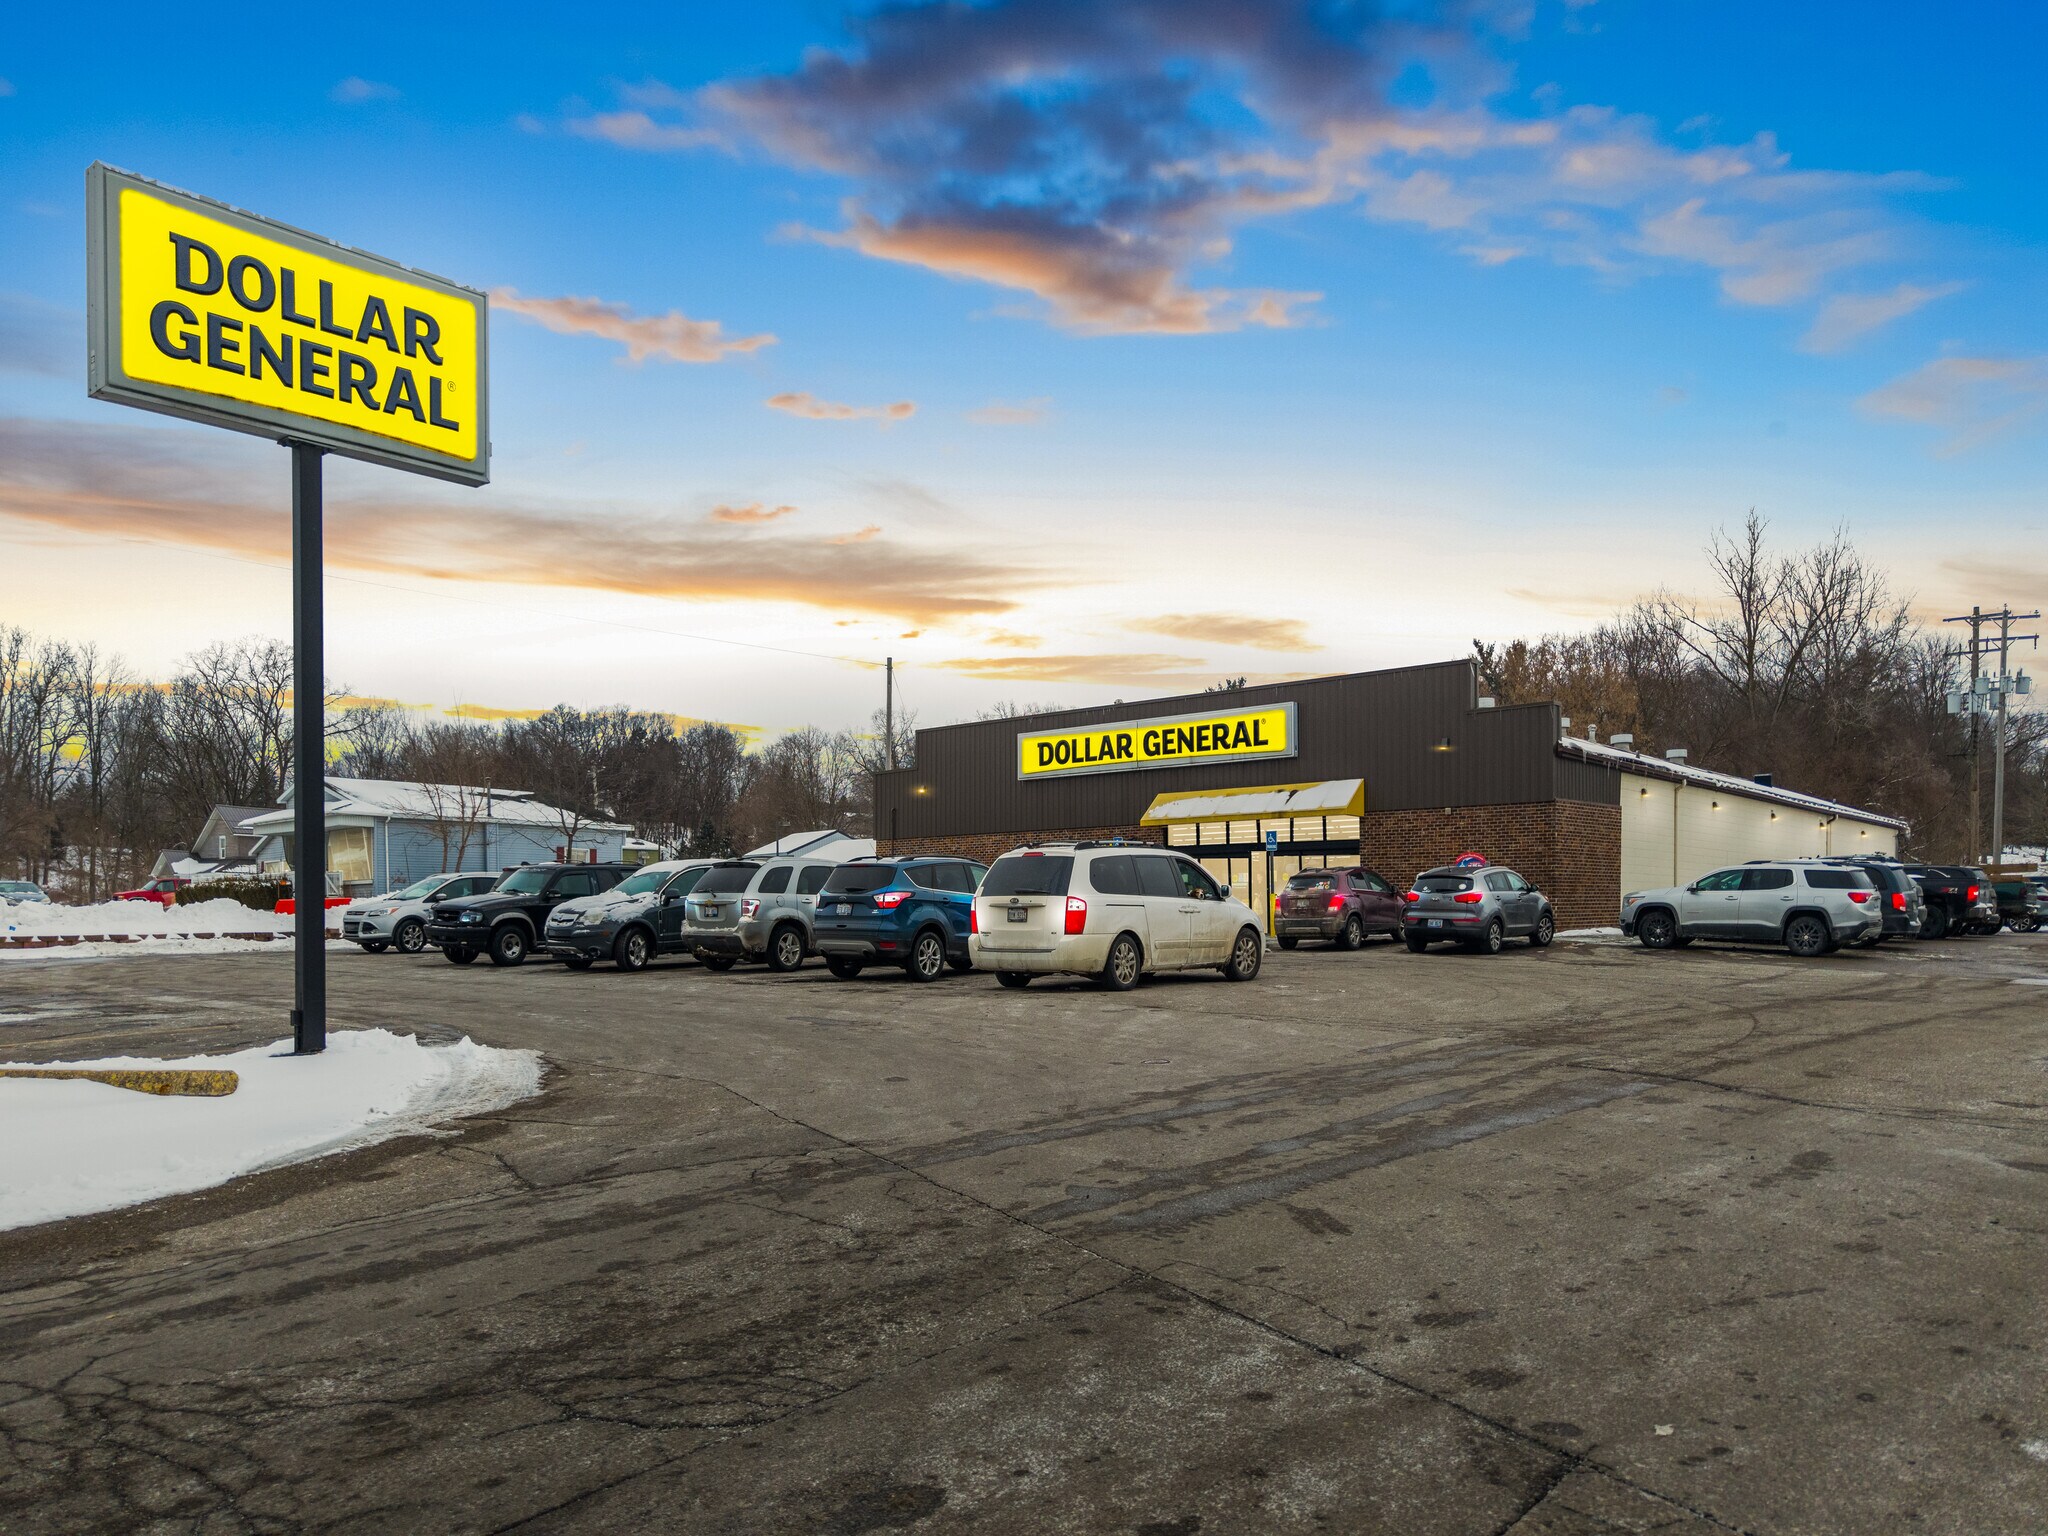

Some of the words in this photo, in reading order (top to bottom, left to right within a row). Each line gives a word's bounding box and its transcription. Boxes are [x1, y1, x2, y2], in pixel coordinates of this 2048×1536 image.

[169, 231, 443, 366] DOLLAR
[149, 300, 460, 432] GENERAL
[1037, 732, 1134, 767] DOLLAR
[1143, 718, 1269, 757] GENERAL
